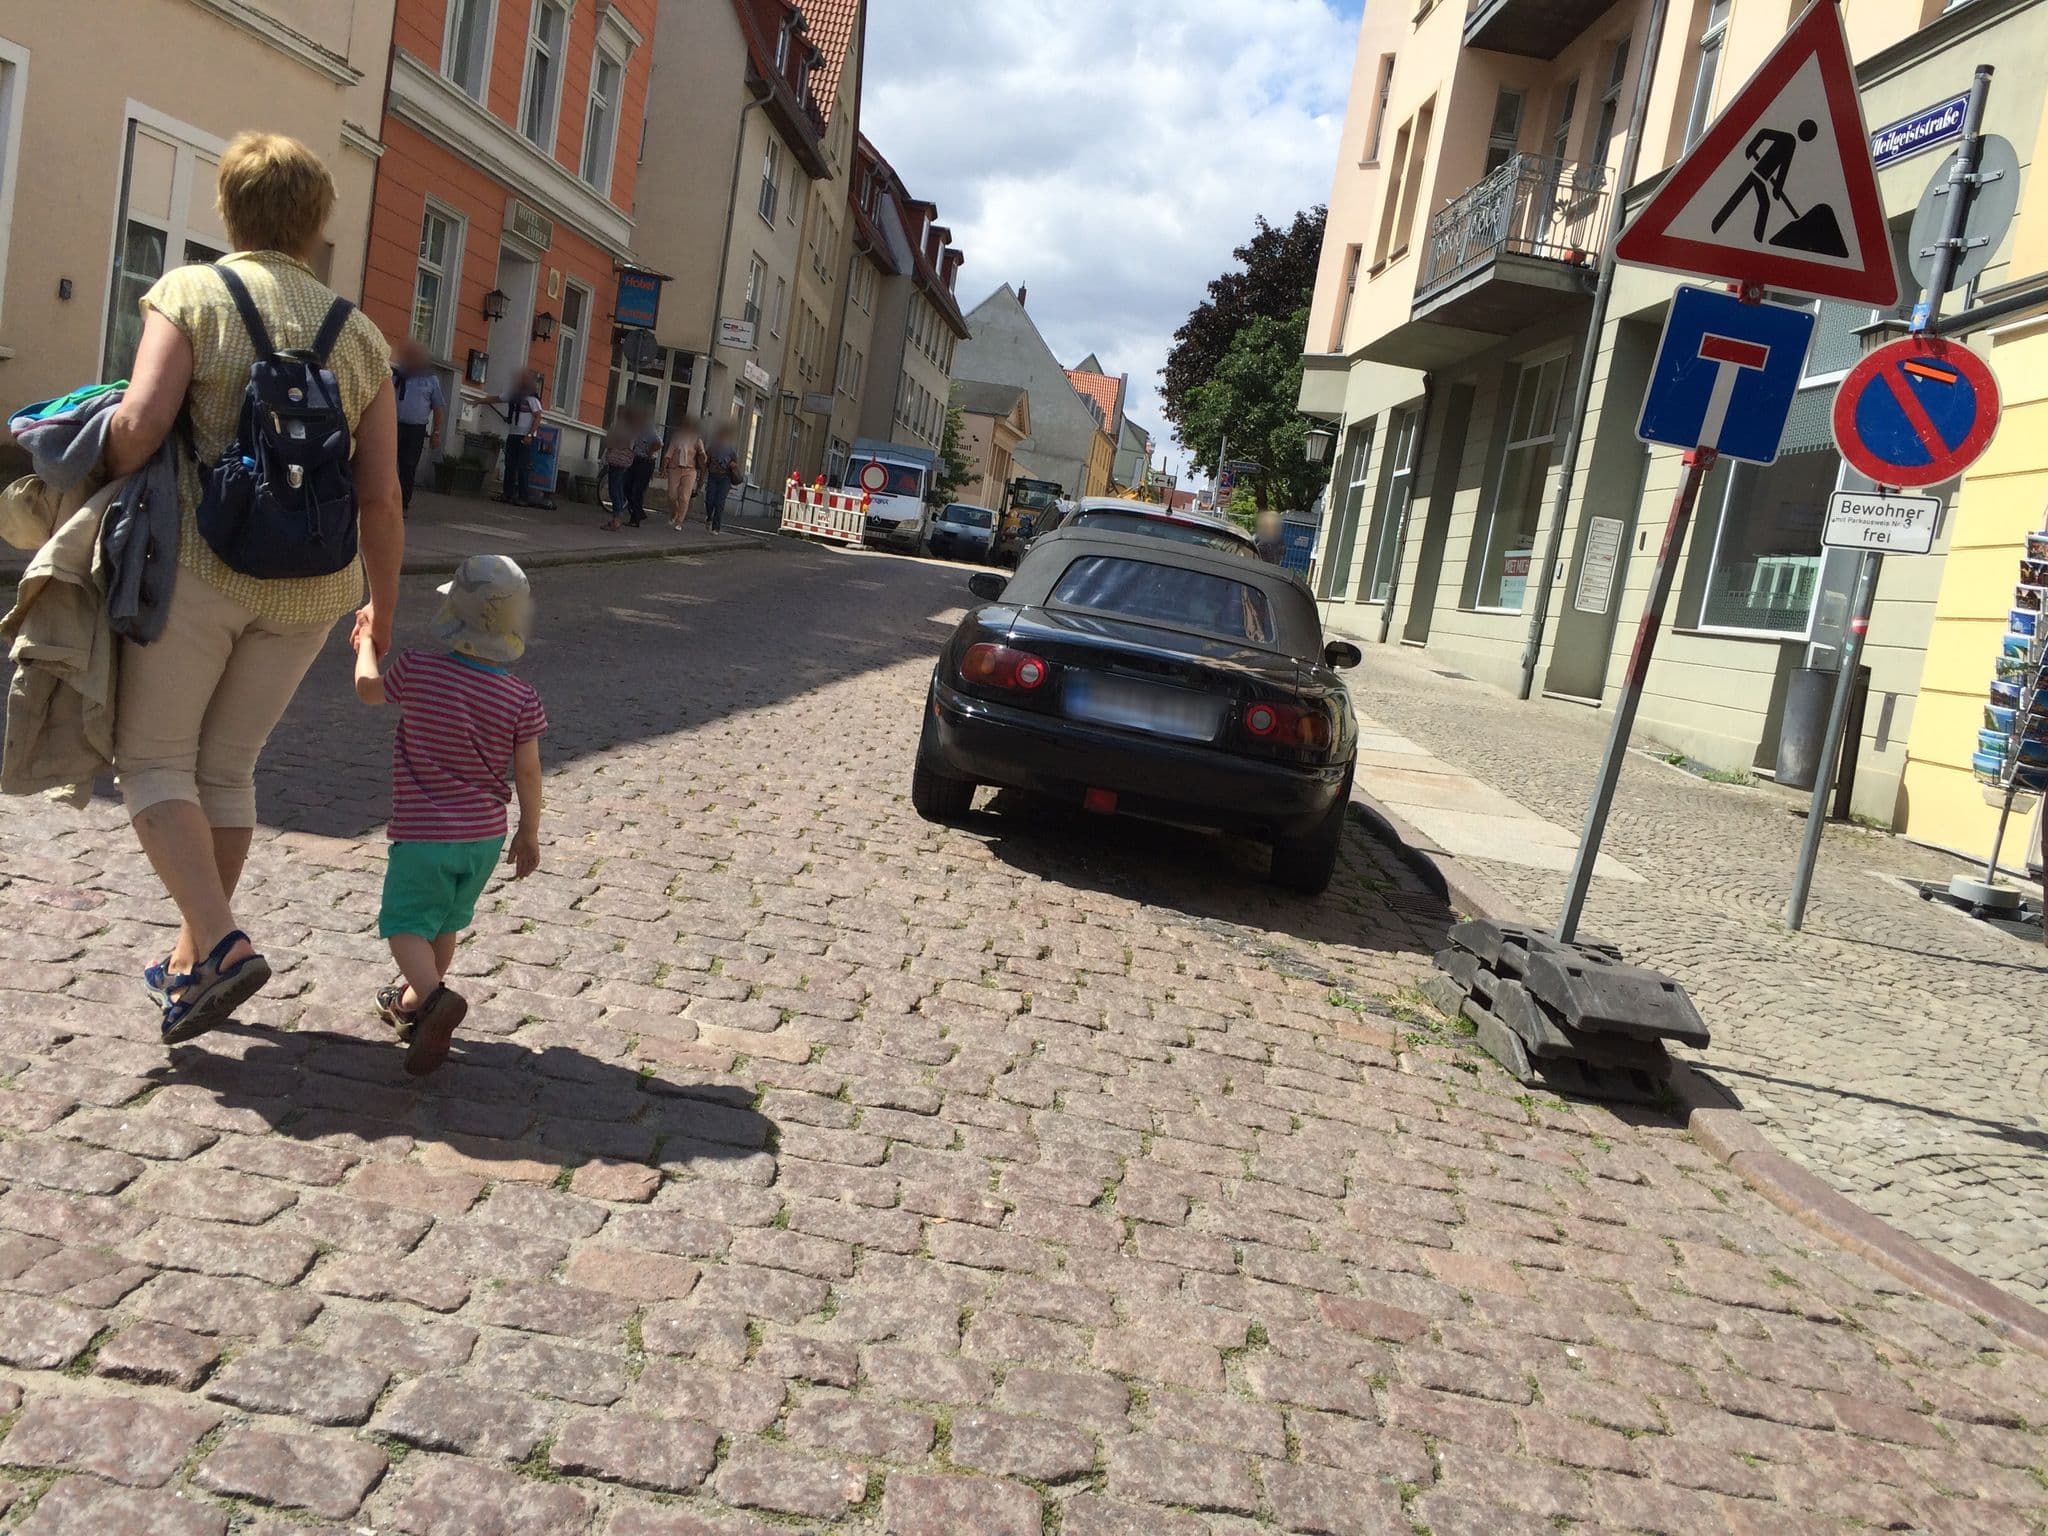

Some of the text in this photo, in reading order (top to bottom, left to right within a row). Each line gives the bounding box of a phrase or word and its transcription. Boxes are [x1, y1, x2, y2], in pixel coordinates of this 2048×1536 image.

[1873, 107, 1960, 157] Heilgeiststraße
[518, 204, 541, 228] HOTEL
[527, 224, 549, 247] AMBER
[1841, 500, 1925, 520] Bewohner
[1847, 516, 1890, 527] Parkausweis
[1902, 518, 1912, 529] 3
[1863, 527, 1891, 544] frei
